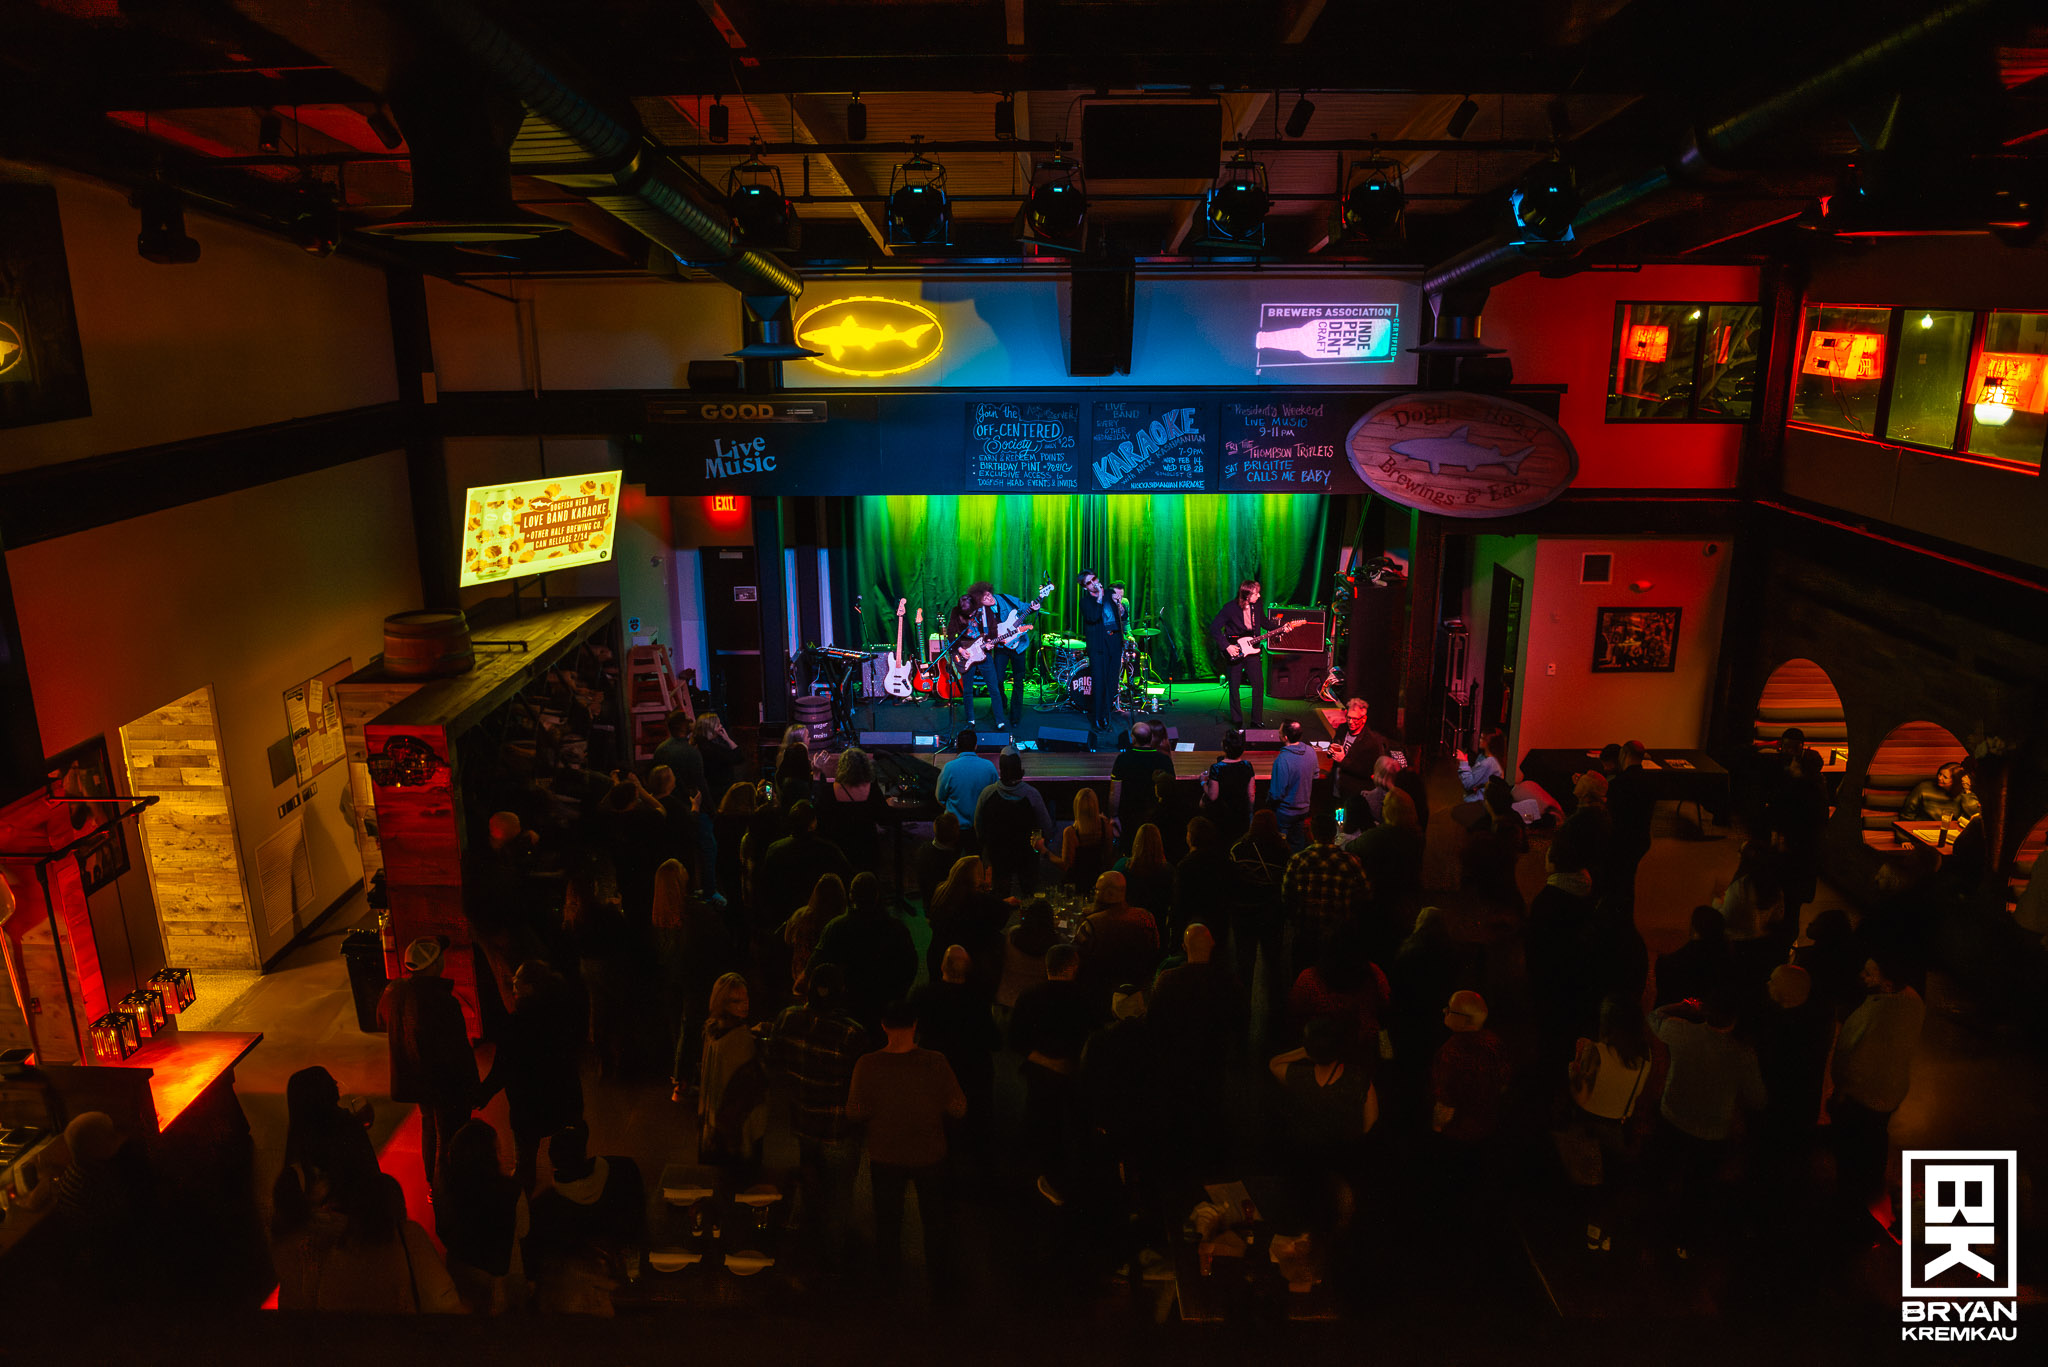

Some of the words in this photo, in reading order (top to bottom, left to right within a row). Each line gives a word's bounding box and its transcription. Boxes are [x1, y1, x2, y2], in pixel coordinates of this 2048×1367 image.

[1268, 308, 1322, 317] BREWERS
[1325, 307, 1392, 317] ASSOCIATION
[1316, 321, 1328, 353] CRAFT
[1327, 321, 1343, 355] DENT
[1343, 321, 1357, 347] PEN
[1356, 321, 1372, 351] INDE
[1390, 318, 1400, 357] CERTIFIED
[700, 404, 774, 420] GOOD
[977, 405, 998, 423] Join
[1004, 405, 1018, 419] the
[1105, 403, 1127, 411] LIVE
[1113, 410, 1140, 419] BAND
[1282, 403, 1324, 417] Weekend
[1271, 417, 1309, 428] MUSIC
[976, 423, 1061, 438] OFF-CENTERED
[1259, 427, 1279, 437] 9-11
[1281, 429, 1295, 437] PM
[713, 436, 766, 459] Live
[986, 435, 1039, 457] Society
[1092, 407, 1200, 489] KARAOKE
[1225, 441, 1238, 452] FRI
[1243, 445, 1292, 459] THOMPSON
[1293, 442, 1334, 459] TRIPLETS
[979, 454, 998, 462] EARN
[1040, 452, 1065, 462] POINTS
[1193, 457, 1202, 465] 14
[704, 451, 777, 479] Music
[979, 462, 1018, 471] BIRTHDAY
[1179, 464, 1192, 472] FEB
[1193, 465, 1204, 473] 28
[1224, 463, 1239, 474] SAT
[1243, 459, 1294, 472] BRIGITTE
[978, 470, 1020, 479] EXCLUSIVE
[1023, 471, 1052, 480] ACCESS
[1246, 471, 1278, 482] CALLS
[1281, 471, 1297, 481] ME
[1301, 470, 1331, 486] BABY
[1378, 455, 1455, 506] Brewings
[1487, 478, 1530, 502] Eats
[1007, 479, 1025, 487] HEAD
[1027, 479, 1051, 487] EVENTS
[1057, 479, 1078, 488] INVITES
[550, 501, 574, 512] DOGFISH
[575, 497, 589, 508] HEAD
[716, 496, 733, 510] EXIT
[523, 513, 544, 529] LOVE
[546, 510, 568, 525] BAND
[571, 502, 607, 521] KARAOKE
[550, 525, 565, 537] HALF
[566, 522, 592, 535] BREWING
[592, 521, 603, 531] CO.
[535, 539, 547, 549] CAN
[548, 534, 572, 547] RELEASE
[573, 532, 588, 544] 2/14
